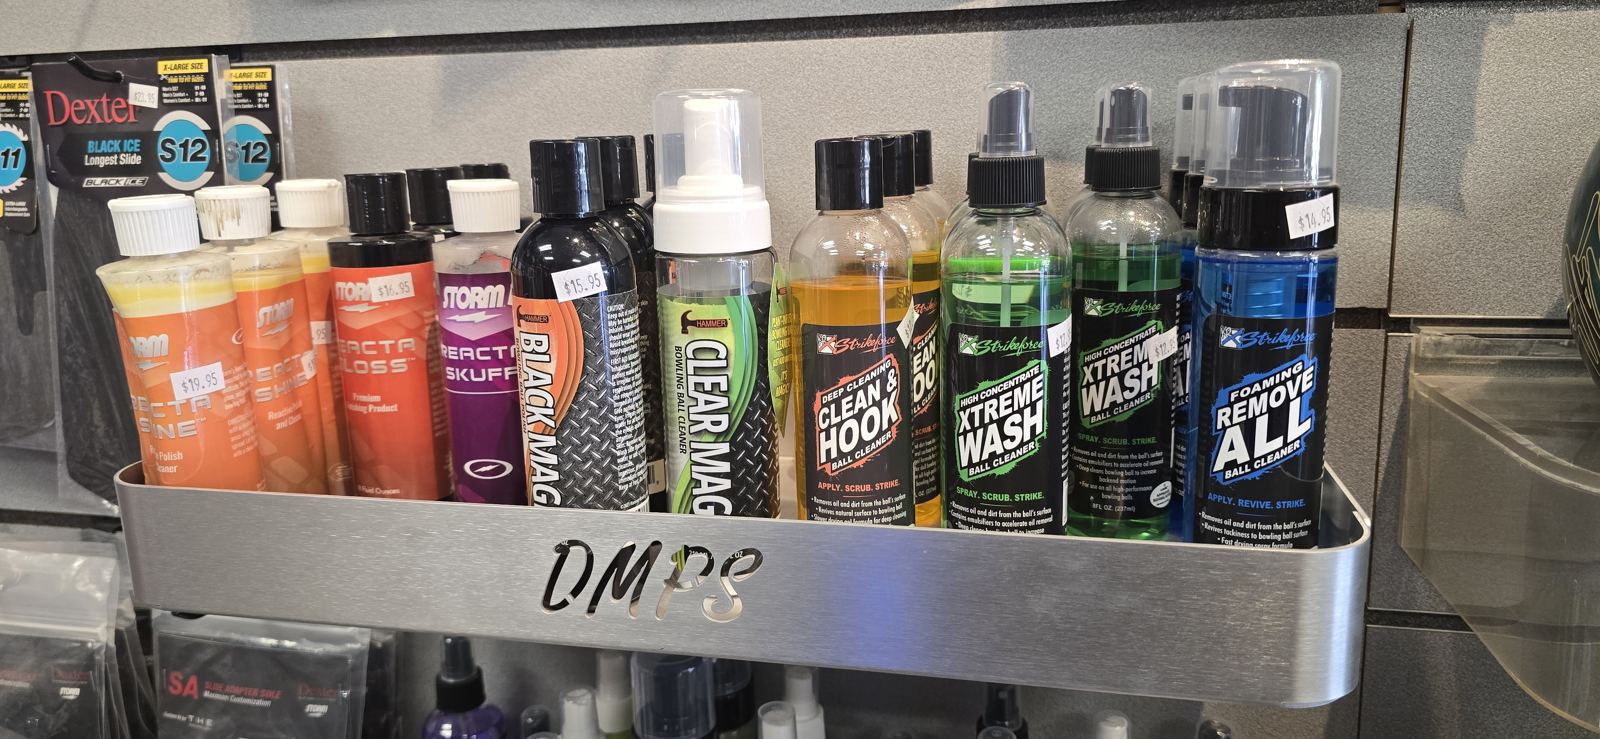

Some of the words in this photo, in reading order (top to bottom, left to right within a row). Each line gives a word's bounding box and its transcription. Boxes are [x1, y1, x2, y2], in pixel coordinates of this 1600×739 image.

[163, 63, 189, 71] X-LARGE
[191, 62, 204, 70] SIZE
[87, 140, 121, 153] BLACK
[123, 139, 141, 152] ICE
[159, 137, 208, 163] S12
[84, 154, 118, 167] Longest
[119, 153, 142, 165] Slide
[85, 177, 123, 186] BLACK
[125, 177, 146, 185] ICE
[1298, 207, 1331, 232] $14.95
[378, 281, 410, 298] $16.95
[443, 284, 505, 309] STORM
[564, 272, 601, 296] $15.95
[257, 297, 293, 329] STORM
[1100, 299, 1161, 317] Strikeforce
[696, 319, 726, 328] HAMMER
[834, 332, 896, 354] Strikeforce
[975, 335, 1043, 356] Strikeforce
[1084, 350, 1102, 363] HIGH
[1103, 324, 1157, 356] CONCENTRATE
[445, 366, 518, 382] SKUFF
[674, 345, 685, 392] BOWLING
[1081, 342, 1150, 387] XTREM
[181, 371, 218, 393] $19.95
[519, 331, 556, 430] BLACK
[685, 338, 730, 435] CLEAR
[822, 387, 844, 404] DEEP
[846, 359, 892, 392] CLEANING
[914, 359, 938, 403] OO
[960, 394, 979, 408] HIGH
[980, 364, 1040, 400] CONCENTRATE
[1081, 360, 1159, 417] WASH
[1230, 362, 1303, 402] FOAMING
[368, 403, 398, 413] Product
[677, 393, 686, 413] BALL
[818, 378, 881, 430] CLEAN
[886, 368, 898, 393] &
[959, 373, 1044, 434] XTREME
[1090, 412, 1111, 424] BALL
[1113, 392, 1151, 415] CLEANER
[1216, 365, 1314, 430] REMOVE
[678, 415, 688, 455] CLEANER
[819, 389, 898, 464] HOOK
[958, 398, 1043, 468] WASH
[1078, 433, 1101, 443] SPRAY.
[1102, 437, 1130, 445] SCRUB.
[1131, 437, 1157, 445] STRIKE.
[1212, 396, 1312, 473] ALL
[159, 451, 183, 461] Polish
[831, 457, 853, 471] BALL
[855, 430, 892, 459] CLEANER
[968, 462, 991, 476] BALL
[992, 441, 1036, 467] CLEANER
[1224, 464, 1251, 480] BALL
[1253, 440, 1301, 470] CLEANER
[817, 481, 843, 492] APPLY.
[844, 482, 873, 492] SCRUB.
[874, 479, 901, 490] STRIKE.
[956, 486, 980, 499] SPRAY.
[982, 492, 1013, 501] SCRUB.
[1014, 491, 1045, 501] STRIKE.
[813, 495, 832, 506] Removes
[832, 499, 840, 507] oil
[818, 506, 835, 515] Revives
[835, 509, 854, 517] natural
[878, 505, 896, 515] bowling
[895, 502, 903, 510] ball
[951, 501, 969, 512] Removes
[976, 508, 987, 517] and
[987, 508, 998, 517] dirt
[998, 510, 1012, 518] from
[1022, 508, 1036, 517] ball's
[1207, 492, 1236, 506] APPLY.
[1237, 499, 1274, 509] REVIVE.
[1275, 498, 1306, 509] STRIKE.
[967, 515, 994, 526] emulsifiers
[1201, 511, 1223, 524] Removes
[1223, 518, 1231, 526] oil
[1232, 520, 1244, 528] and
[1245, 521, 1256, 529] dirt
[1257, 522, 1272, 530] from
[1272, 521, 1282, 530] the
[1283, 521, 1297, 530] ball's
[1204, 522, 1223, 534] Revives
[1223, 528, 1250, 539] tackiness
[1250, 532, 1258, 540] to
[1258, 532, 1281, 541] bowling
[1282, 531, 1293, 539] ball
[541, 539, 764, 623] DMPS
[168, 671, 199, 700] SA
